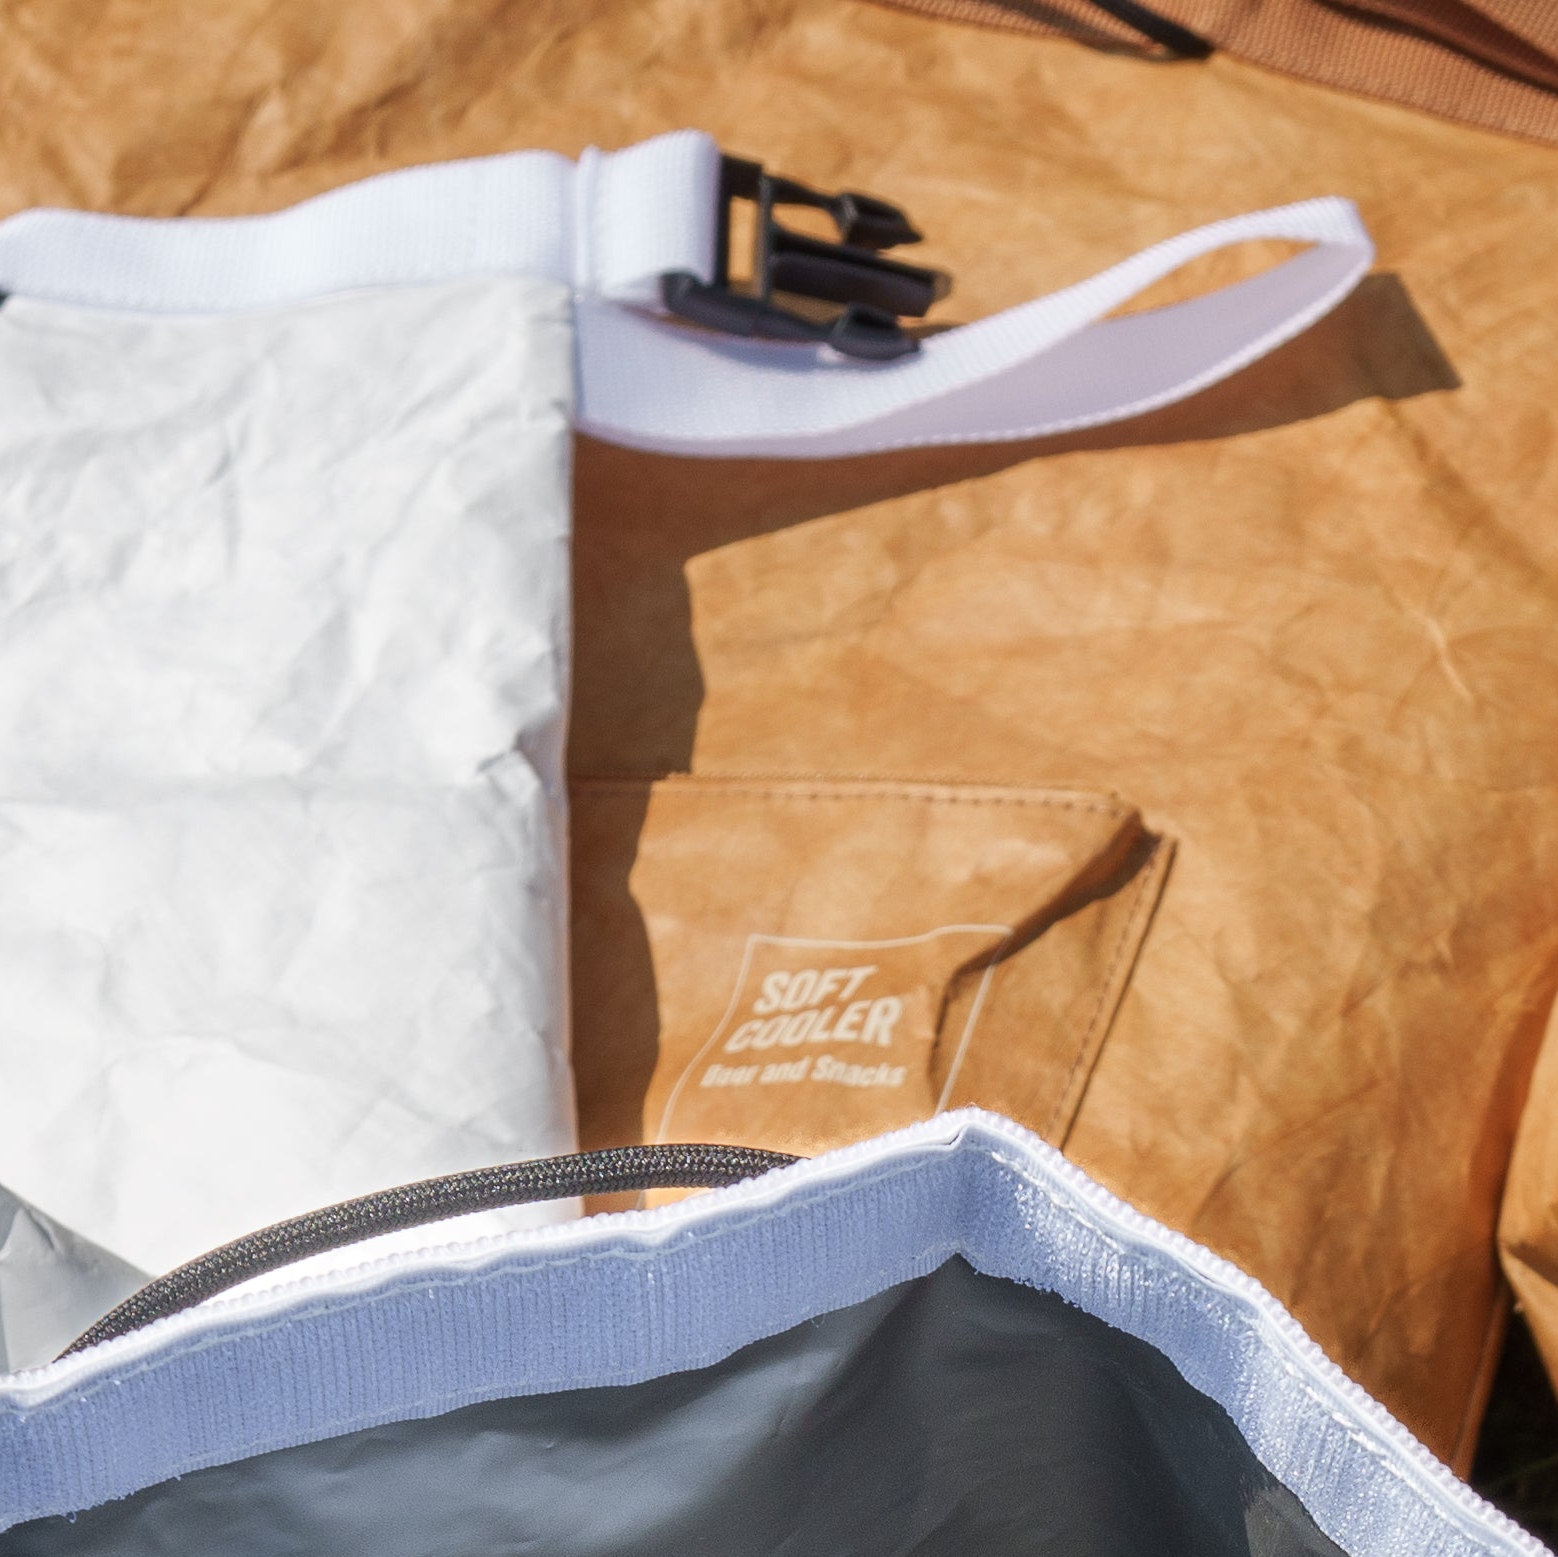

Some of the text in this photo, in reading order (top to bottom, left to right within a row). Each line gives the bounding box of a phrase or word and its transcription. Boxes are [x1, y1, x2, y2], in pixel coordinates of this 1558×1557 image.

[726, 967, 902, 1052] SOFT COOLER
[761, 1056, 810, 1084] and
[812, 1055, 906, 1086] Snacks
